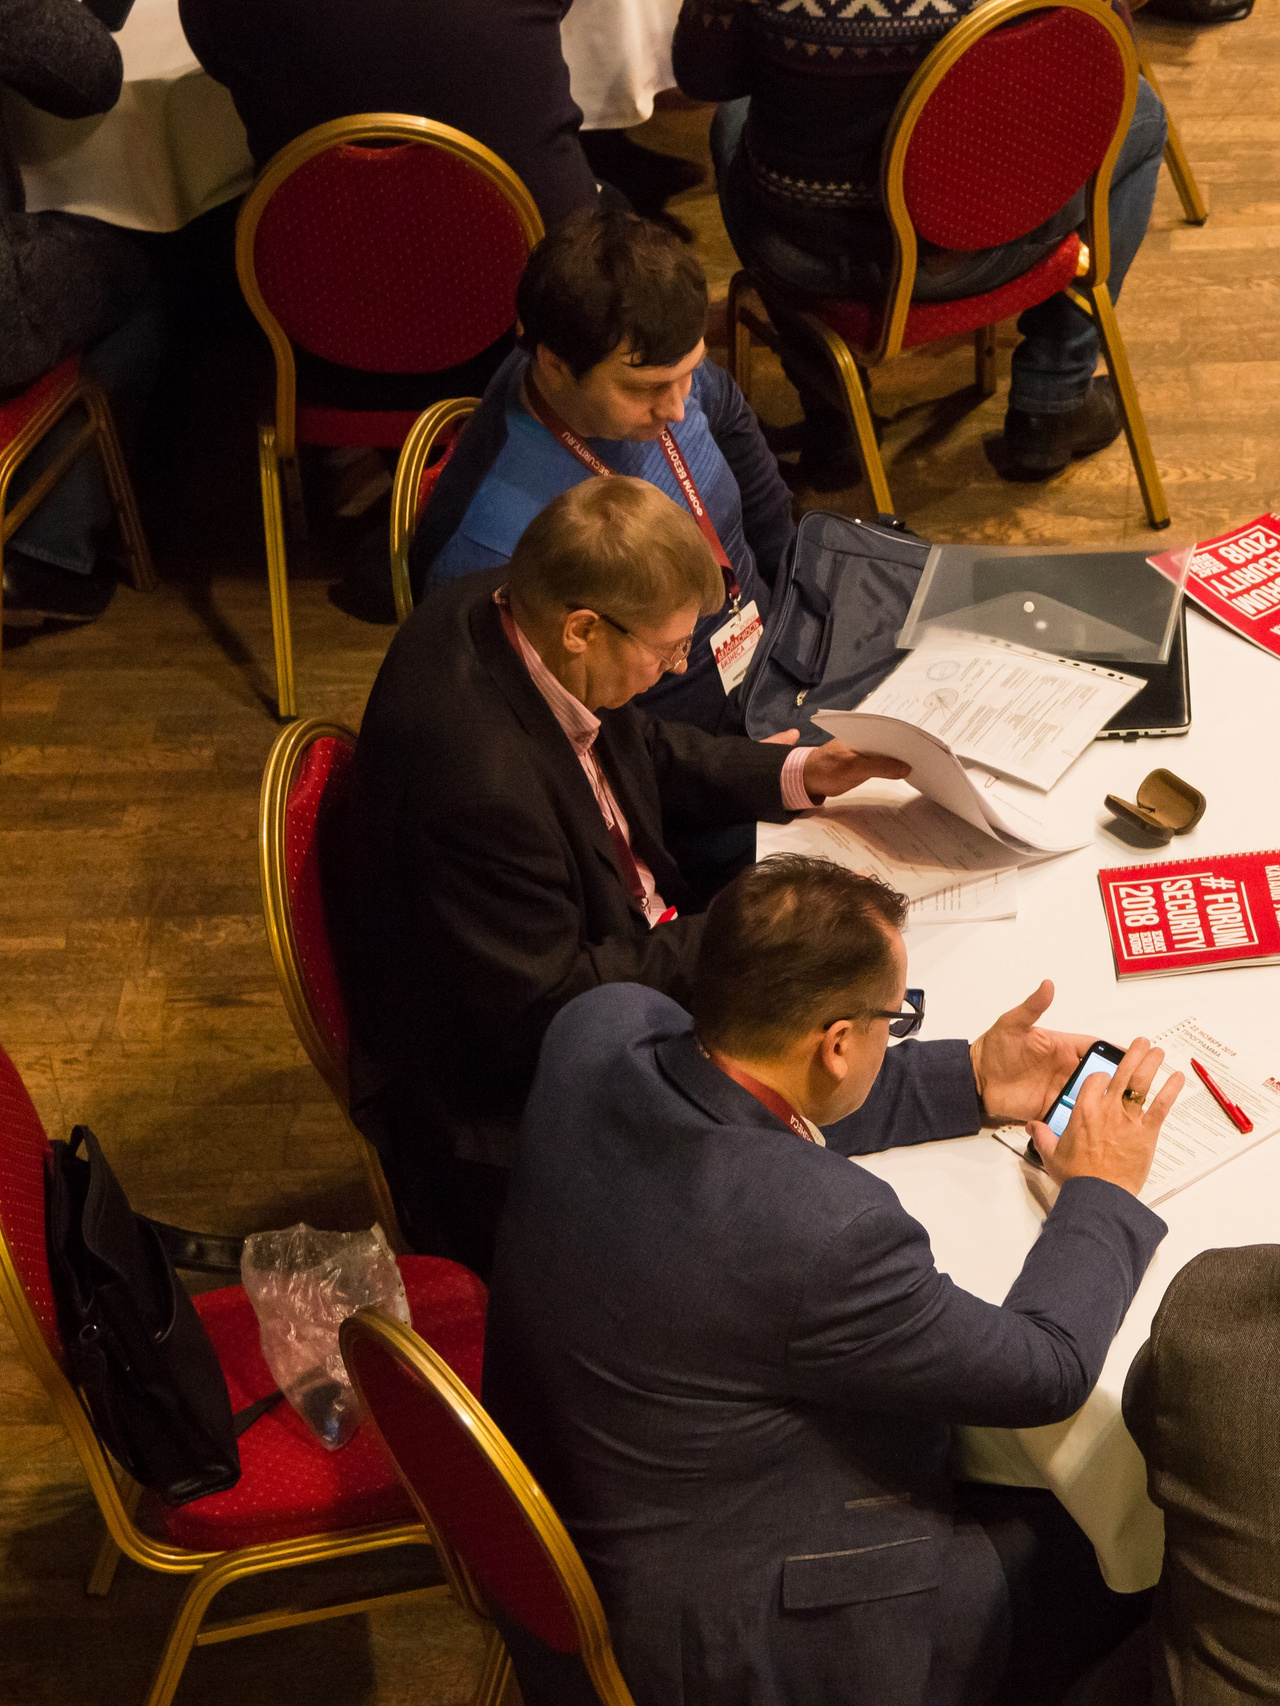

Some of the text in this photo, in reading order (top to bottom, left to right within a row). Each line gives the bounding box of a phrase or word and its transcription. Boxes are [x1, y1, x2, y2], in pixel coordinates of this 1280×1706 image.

[682, 479, 703, 517] ФОРУМ
[1218, 531, 1278, 564] 2018
[1119, 885, 1160, 927] 2018
[1161, 879, 1207, 949] SECURITY
[1203, 892, 1249, 947] FORUM
[1181, 1029, 1221, 1057] ПРОГРАММА
